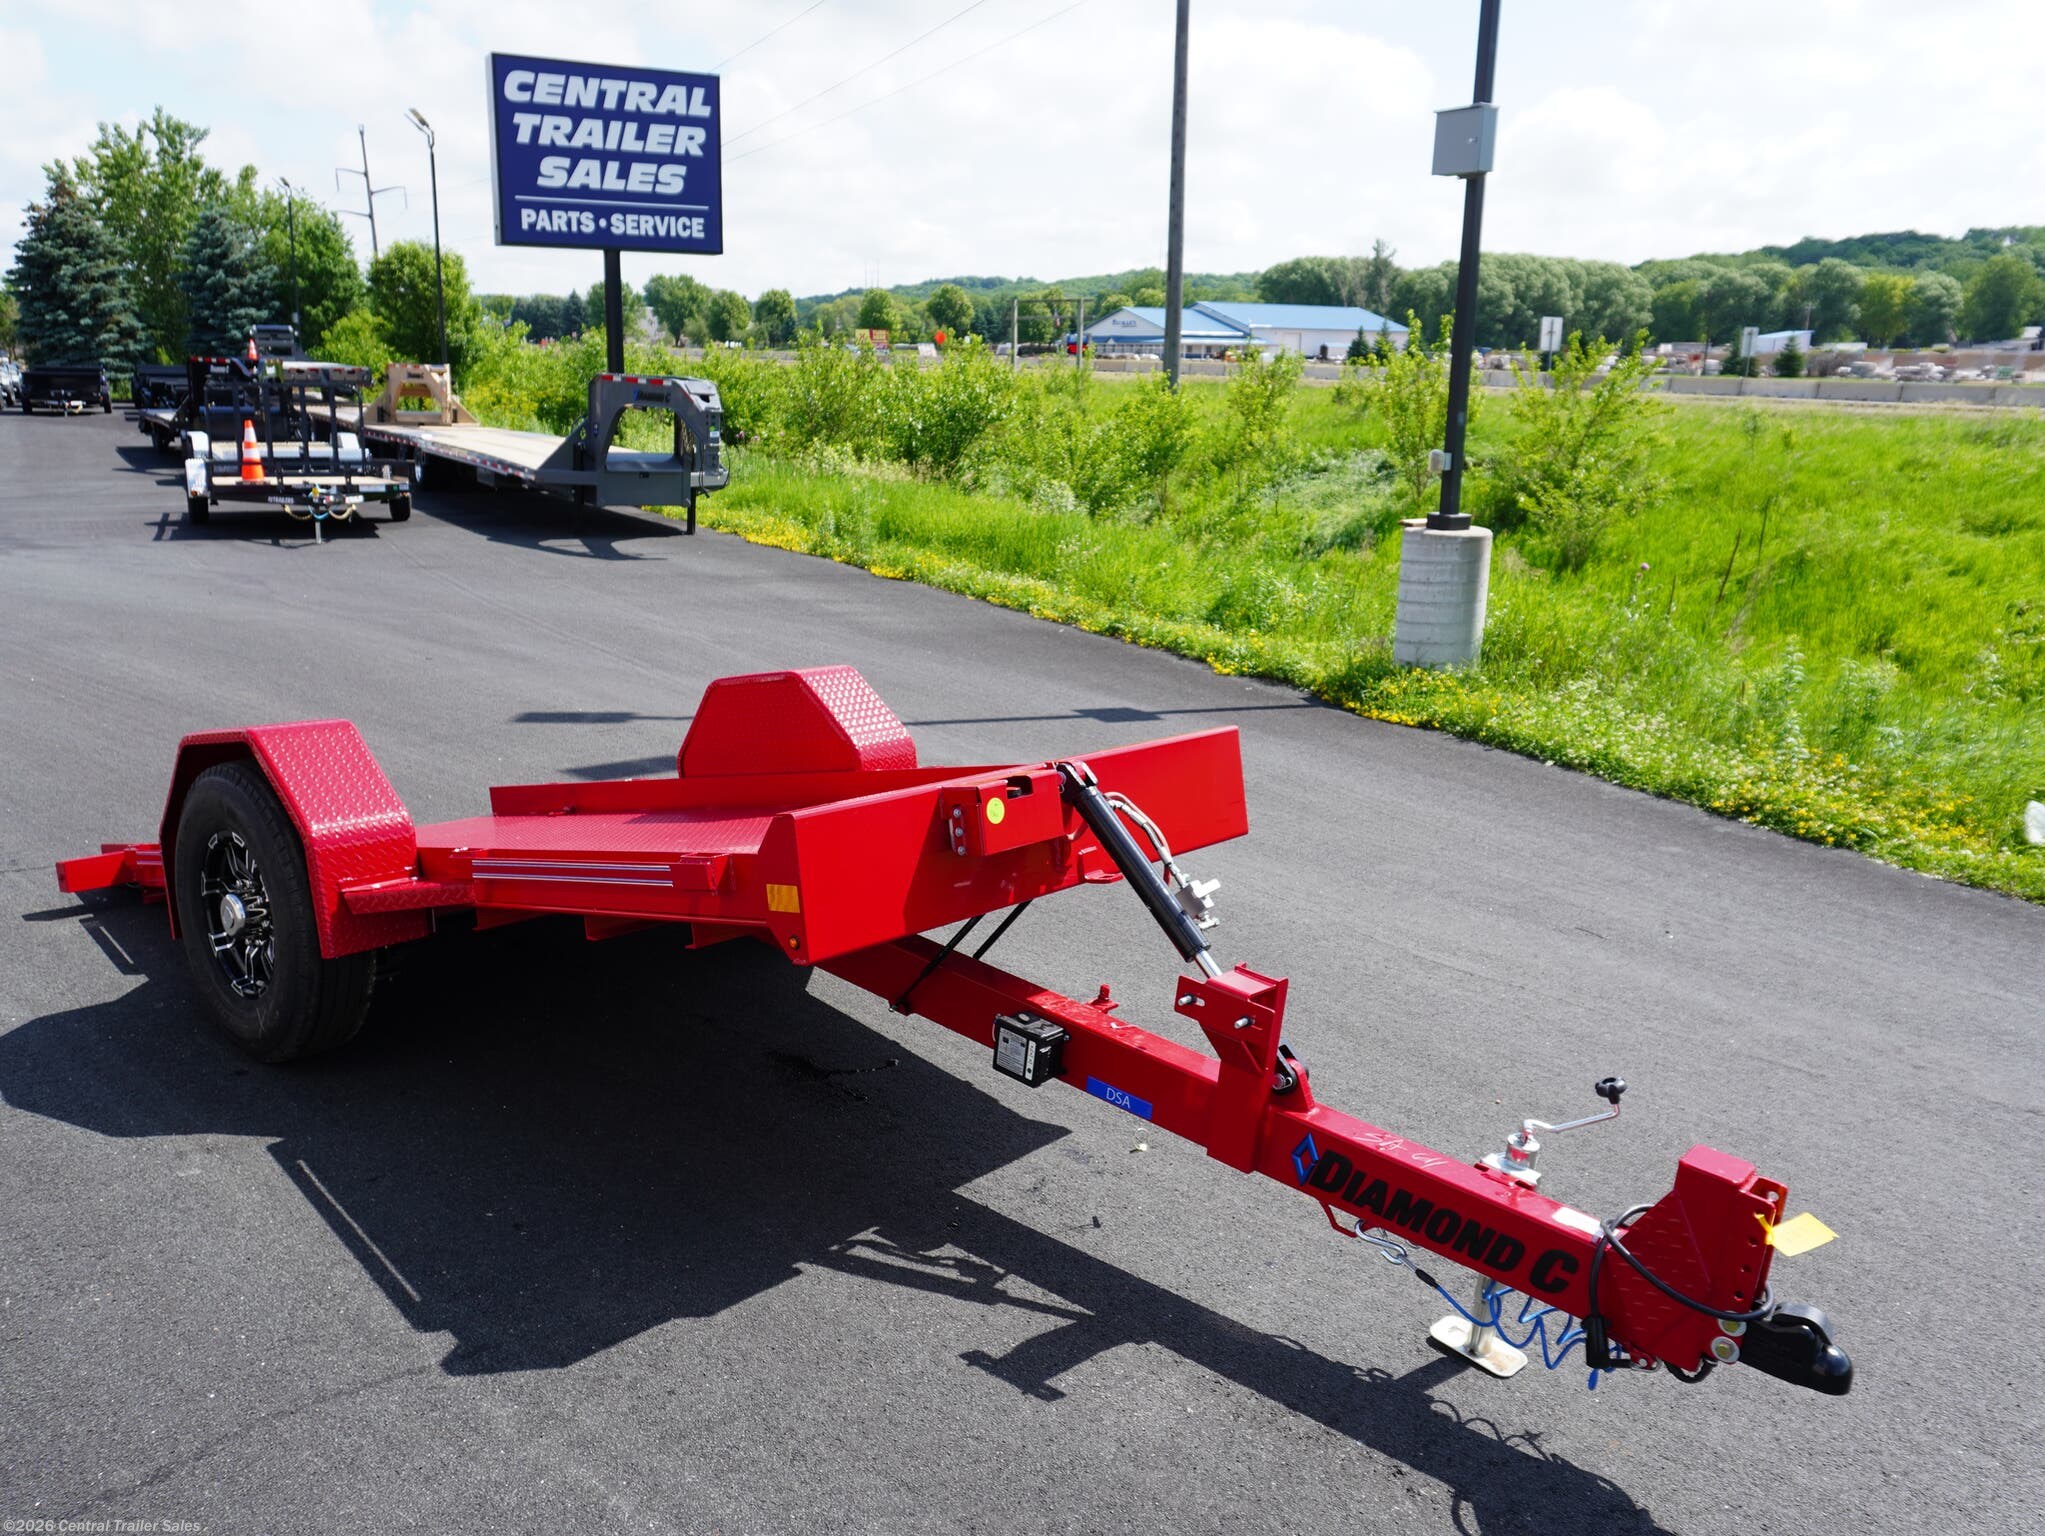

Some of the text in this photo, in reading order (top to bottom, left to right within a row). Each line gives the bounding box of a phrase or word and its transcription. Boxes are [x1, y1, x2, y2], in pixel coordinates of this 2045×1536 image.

[504, 70, 711, 118] CENTRAL
[512, 112, 706, 157] TRAILER
[536, 156, 687, 195] SALES
[521, 208, 705, 239] PARTS SERVICE
[1106, 1087, 1131, 1109] DSA
[1308, 1150, 1580, 1294] DIAMOND C
